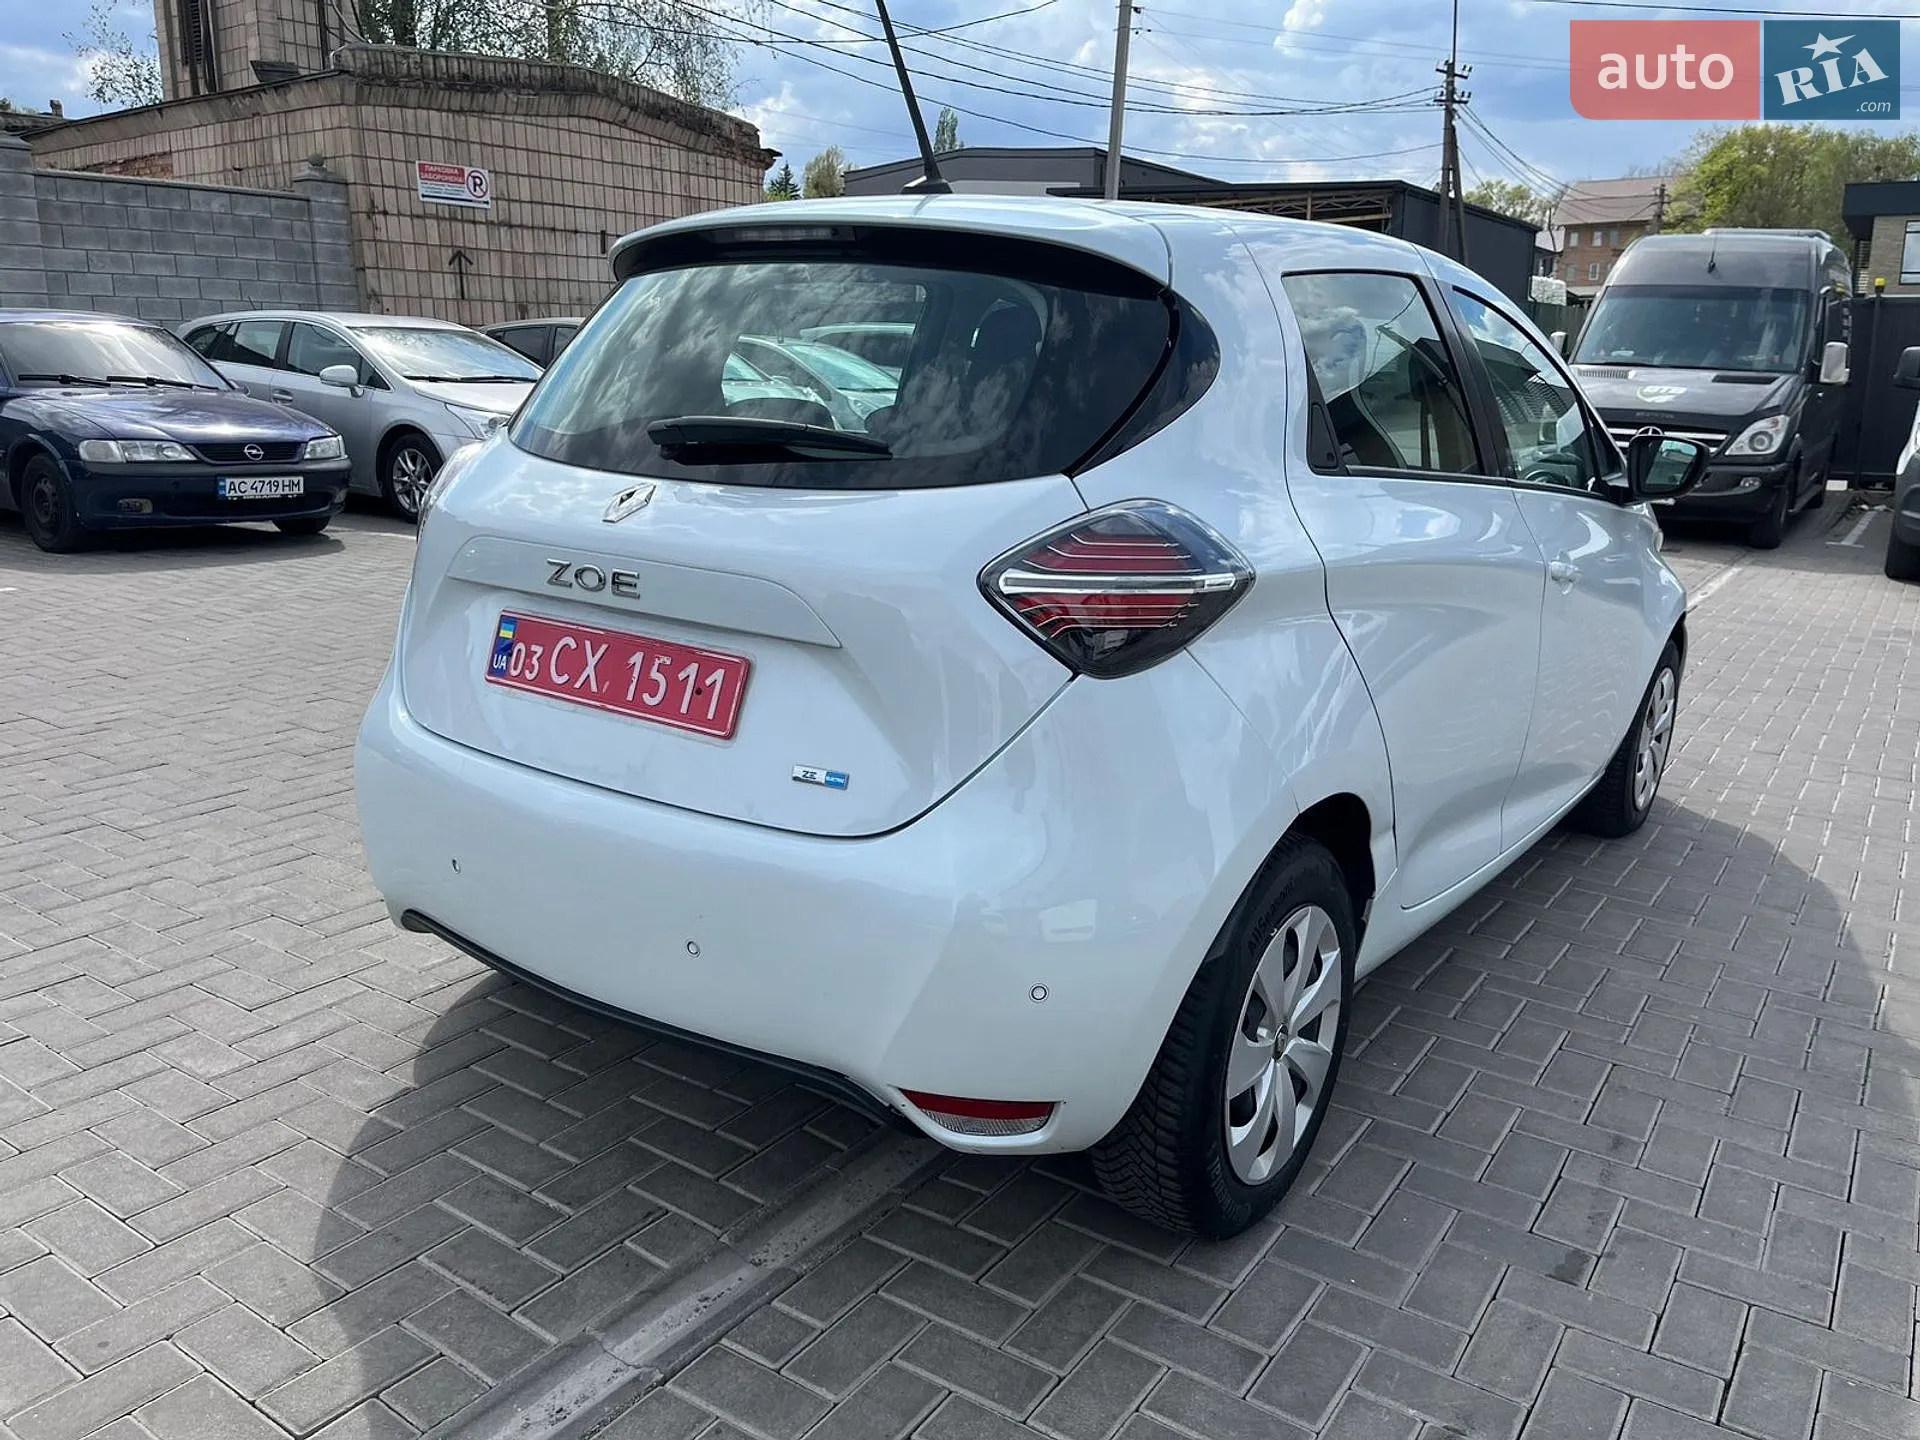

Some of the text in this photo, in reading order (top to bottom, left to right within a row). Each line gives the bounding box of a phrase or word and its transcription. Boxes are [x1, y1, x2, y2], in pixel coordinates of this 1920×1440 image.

[227, 479, 300, 494] AC 4719 HM
[546, 558, 640, 600] ZOE
[492, 654, 508, 671] UA
[509, 636, 726, 721] 03 CX 1511
